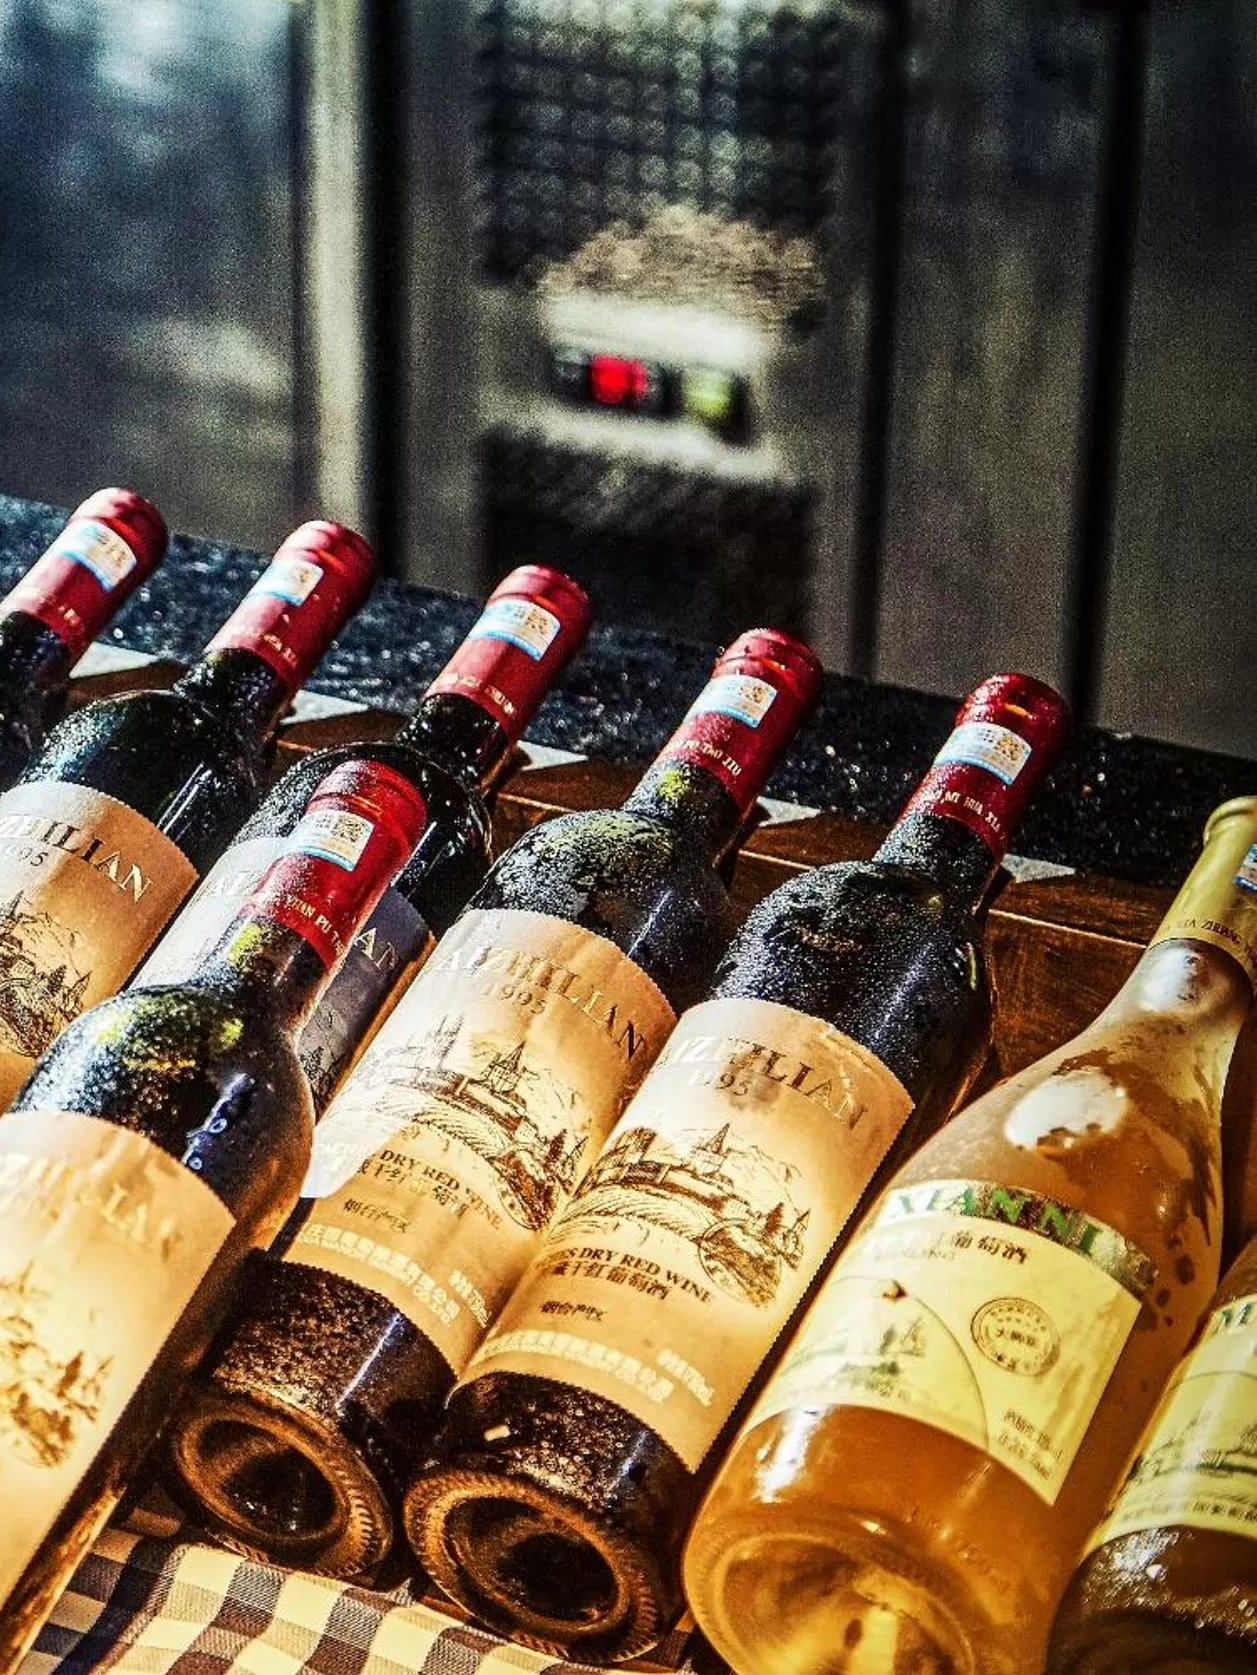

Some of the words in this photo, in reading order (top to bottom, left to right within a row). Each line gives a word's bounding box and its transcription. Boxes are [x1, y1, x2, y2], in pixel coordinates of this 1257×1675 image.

[379, 1148, 422, 1175] DRY
[424, 1164, 462, 1193] RED
[579, 1246, 620, 1270] DRY
[619, 1250, 662, 1280] RED
[663, 1266, 713, 1305] WINE
